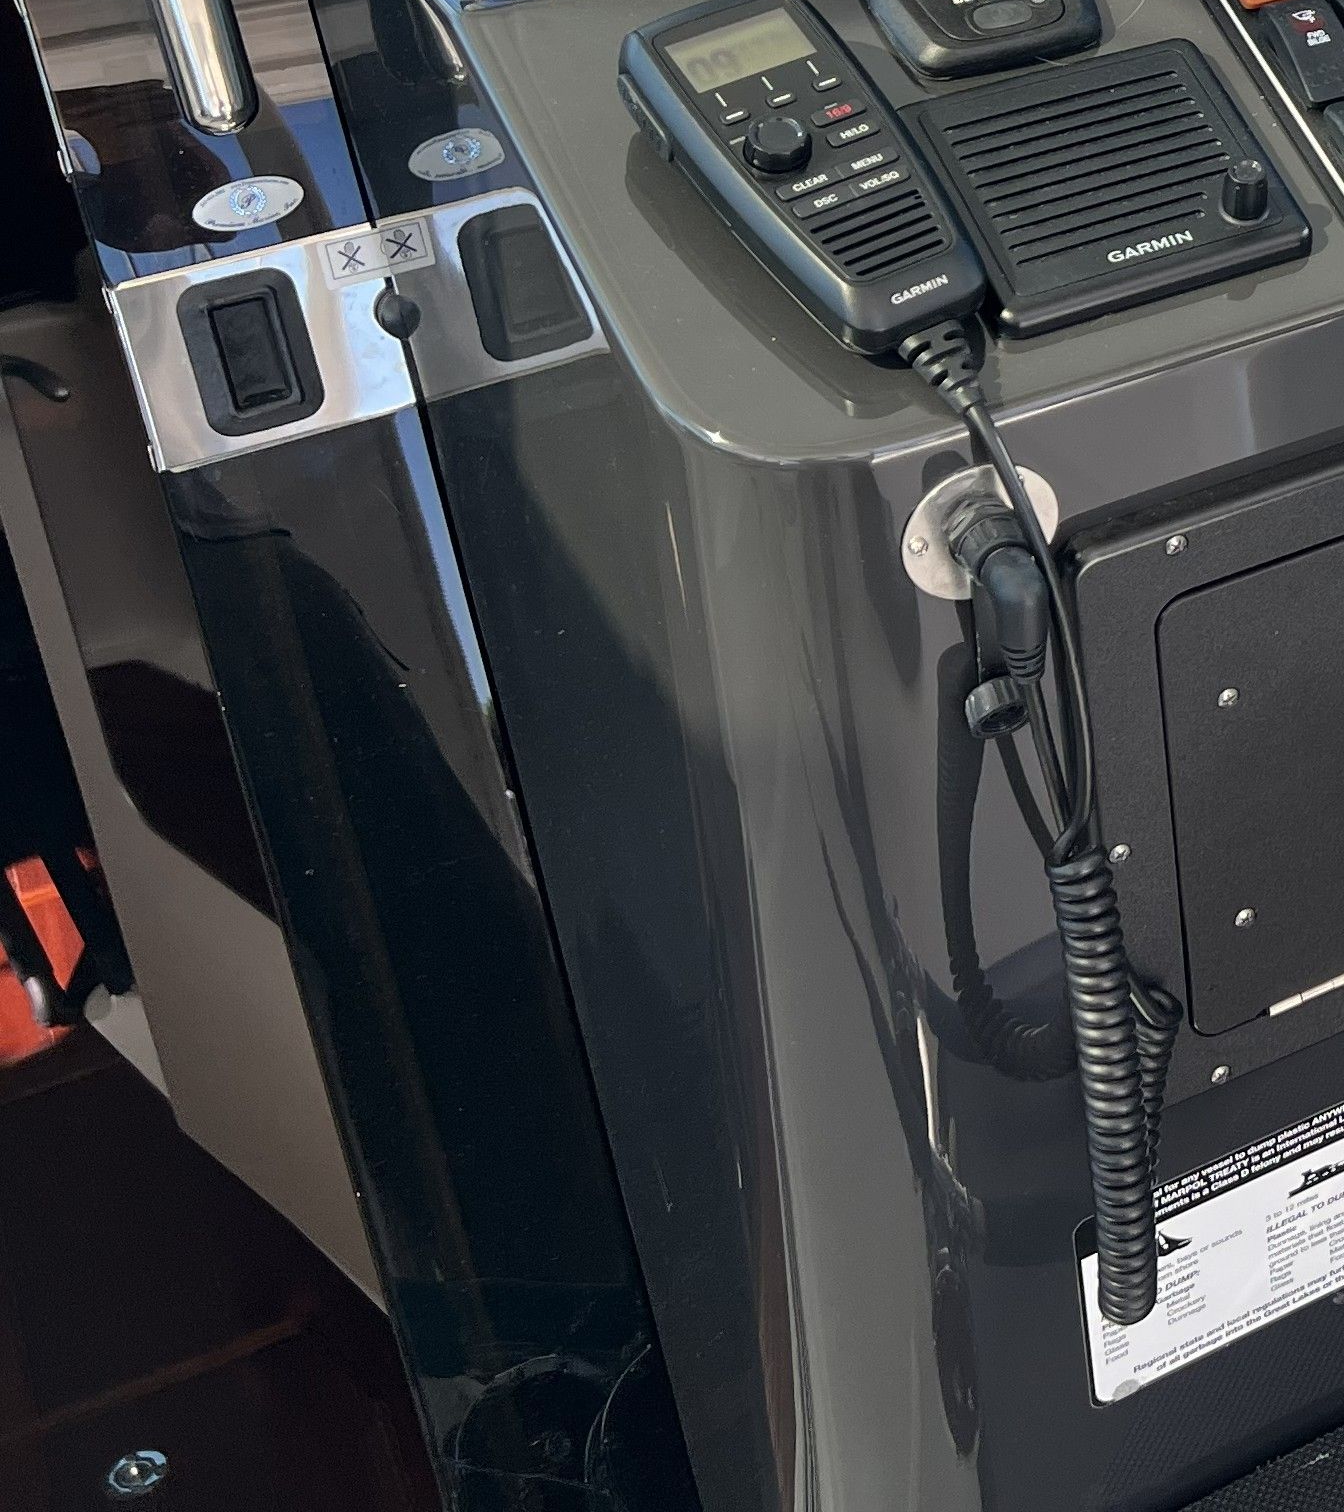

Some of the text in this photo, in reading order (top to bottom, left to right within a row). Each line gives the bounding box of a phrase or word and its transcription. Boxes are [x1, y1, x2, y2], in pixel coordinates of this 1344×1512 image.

[826, 104, 852, 119] 16/9
[839, 123, 870, 139] HI/LO
[850, 153, 883, 170] MENU
[792, 174, 828, 193] CLEAR
[858, 170, 900, 191] VOL/SQ
[813, 193, 839, 208] DSC
[1106, 230, 1194, 263] GARMIN
[890, 274, 949, 305] GARMIN
